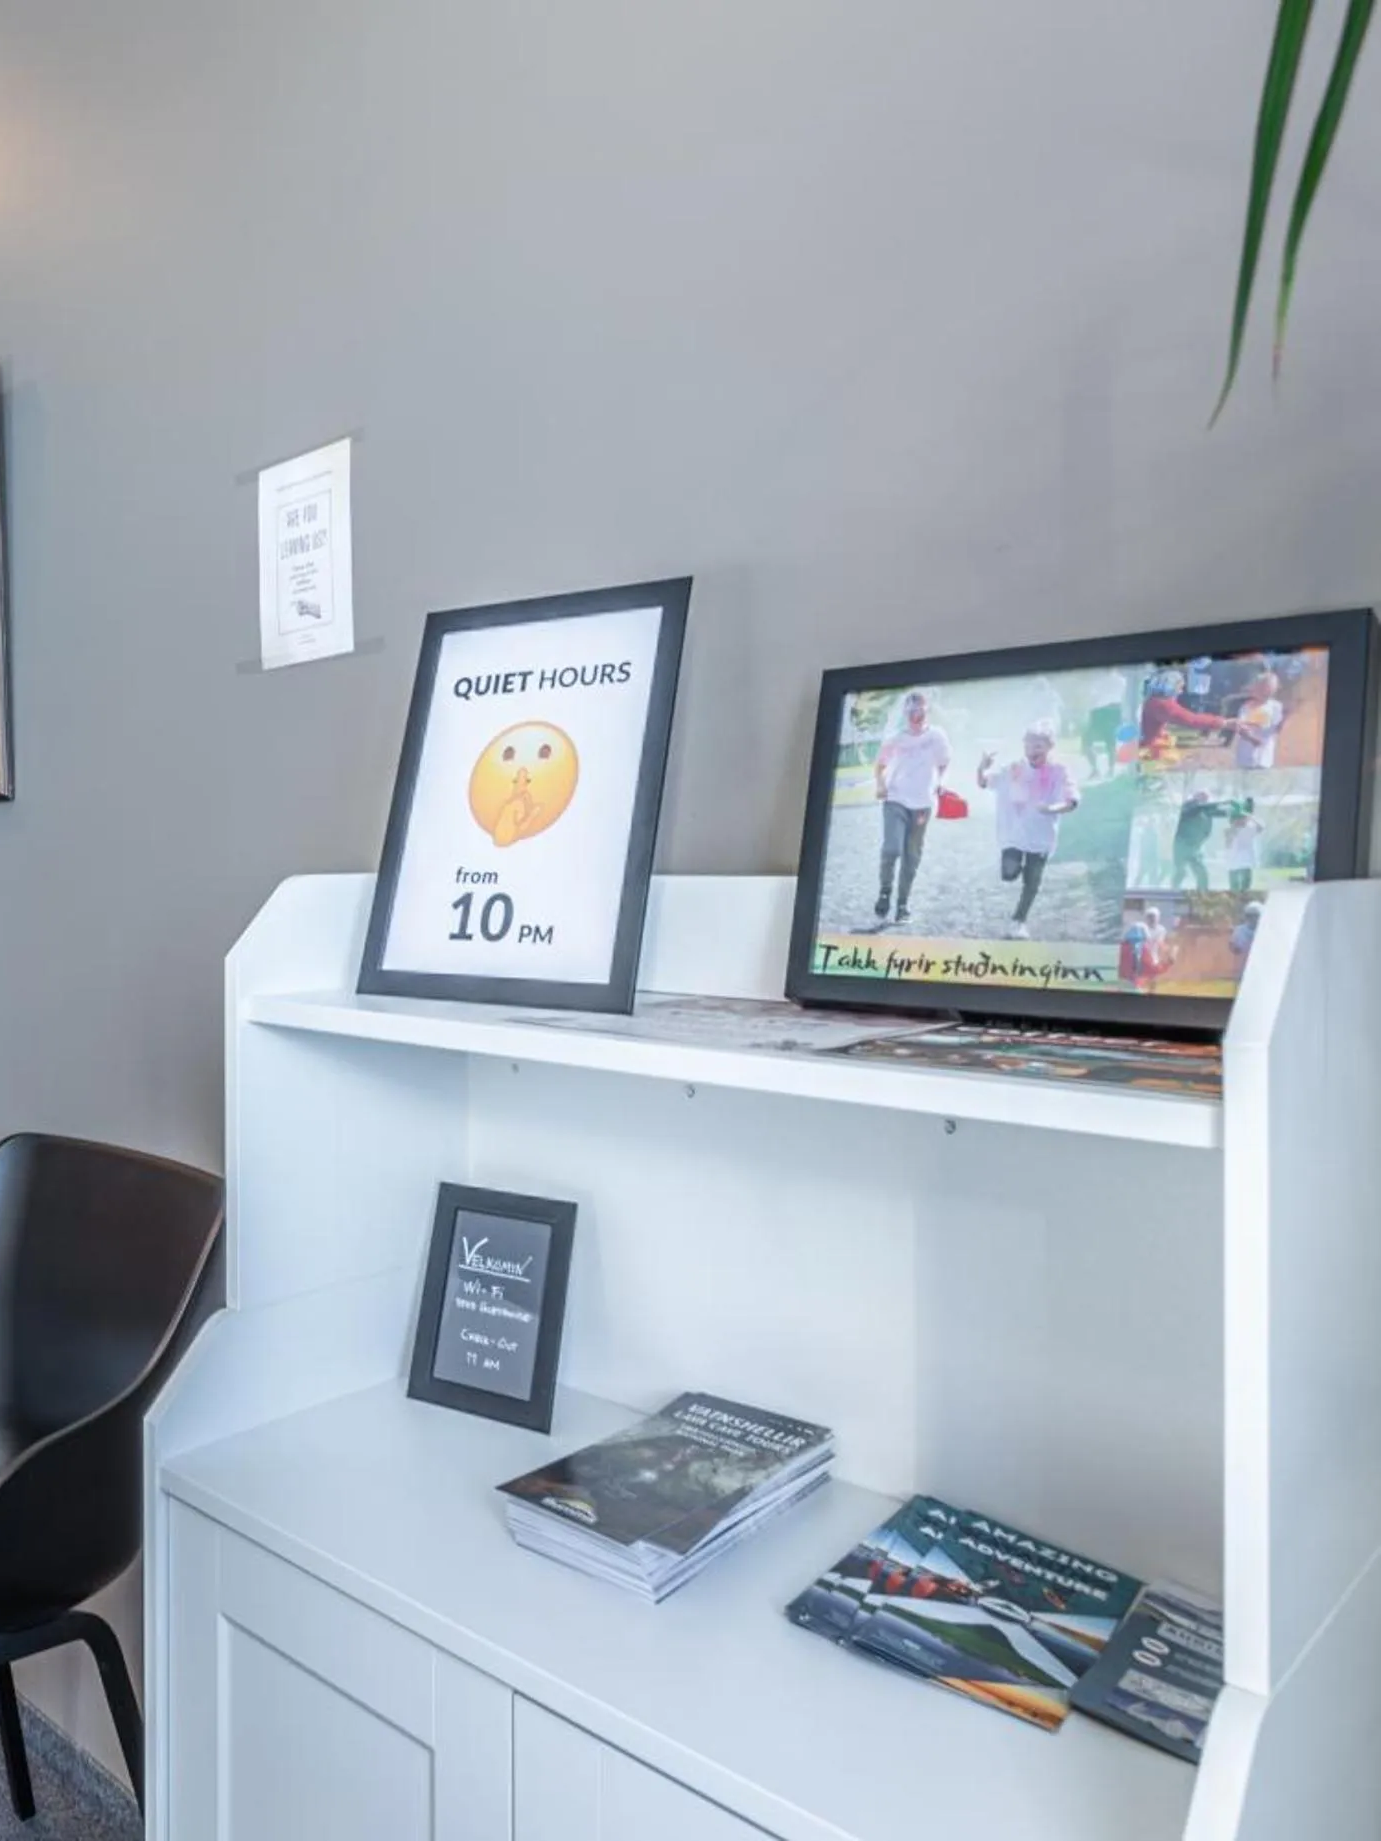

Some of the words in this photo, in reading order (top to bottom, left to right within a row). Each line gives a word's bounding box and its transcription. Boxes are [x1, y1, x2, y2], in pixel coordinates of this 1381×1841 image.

[453, 670, 534, 700] QUIET
[538, 662, 632, 690] HOURS
[455, 867, 499, 885] from
[448, 891, 514, 943] 10
[517, 925, 554, 945] PM
[818, 944, 879, 972] Takk
[885, 951, 935, 978] fyrir
[958, 1536, 1109, 1601] ADVENTURE
[970, 1519, 1119, 1583] AMAZING
